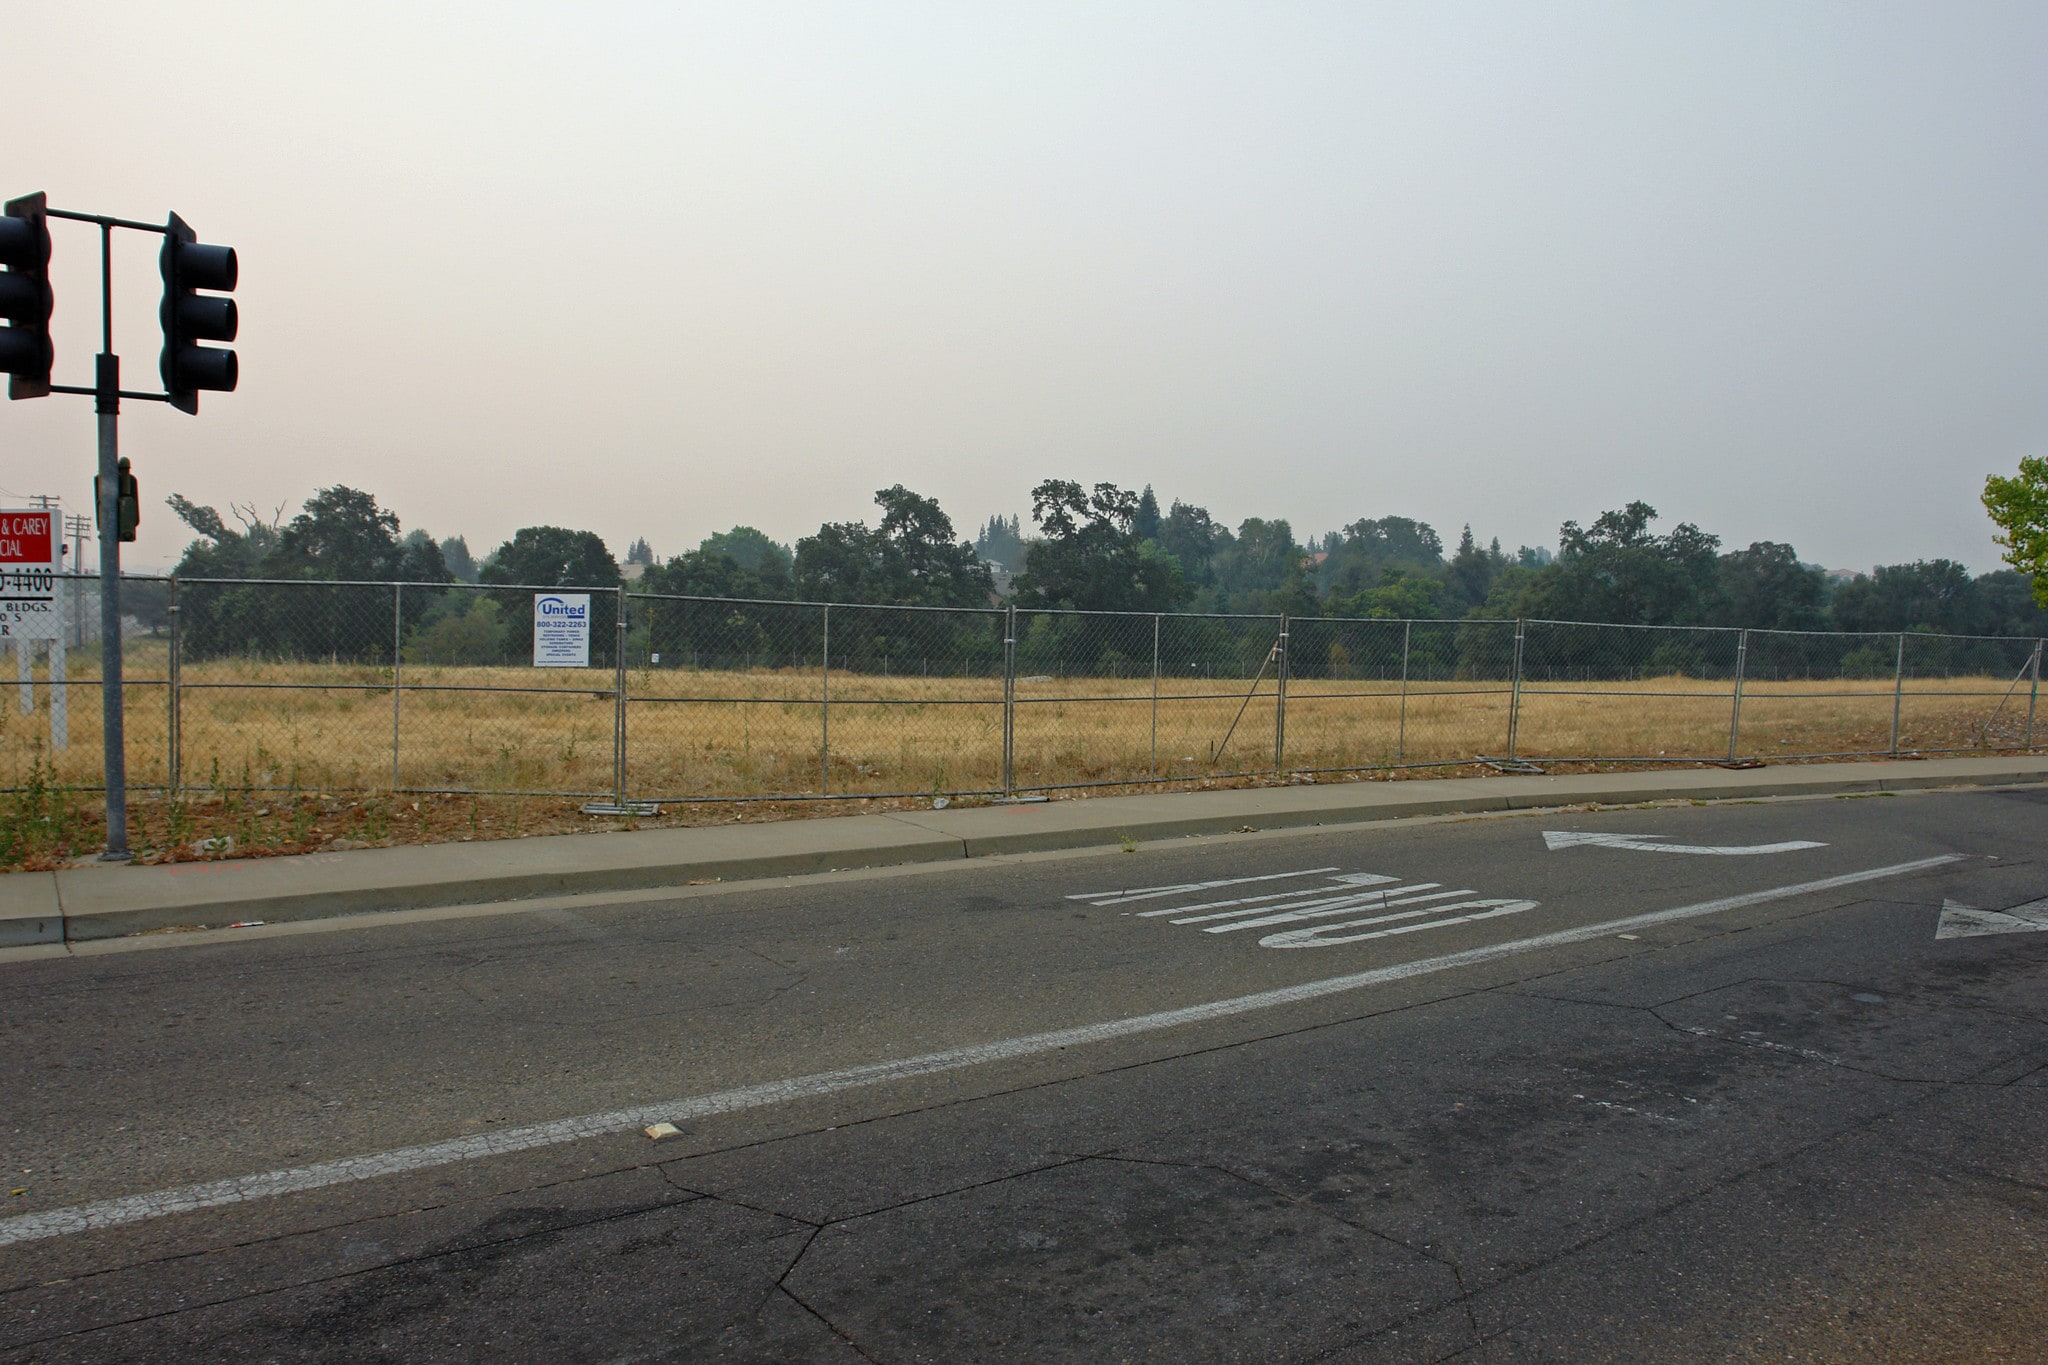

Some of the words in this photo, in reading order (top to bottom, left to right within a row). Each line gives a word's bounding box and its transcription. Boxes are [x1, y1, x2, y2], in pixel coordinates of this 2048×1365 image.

[1, 518, 10, 535] &
[13, 517, 48, 536] CAREY
[6, 602, 52, 612] BLDGS.
[542, 604, 585, 614] United
